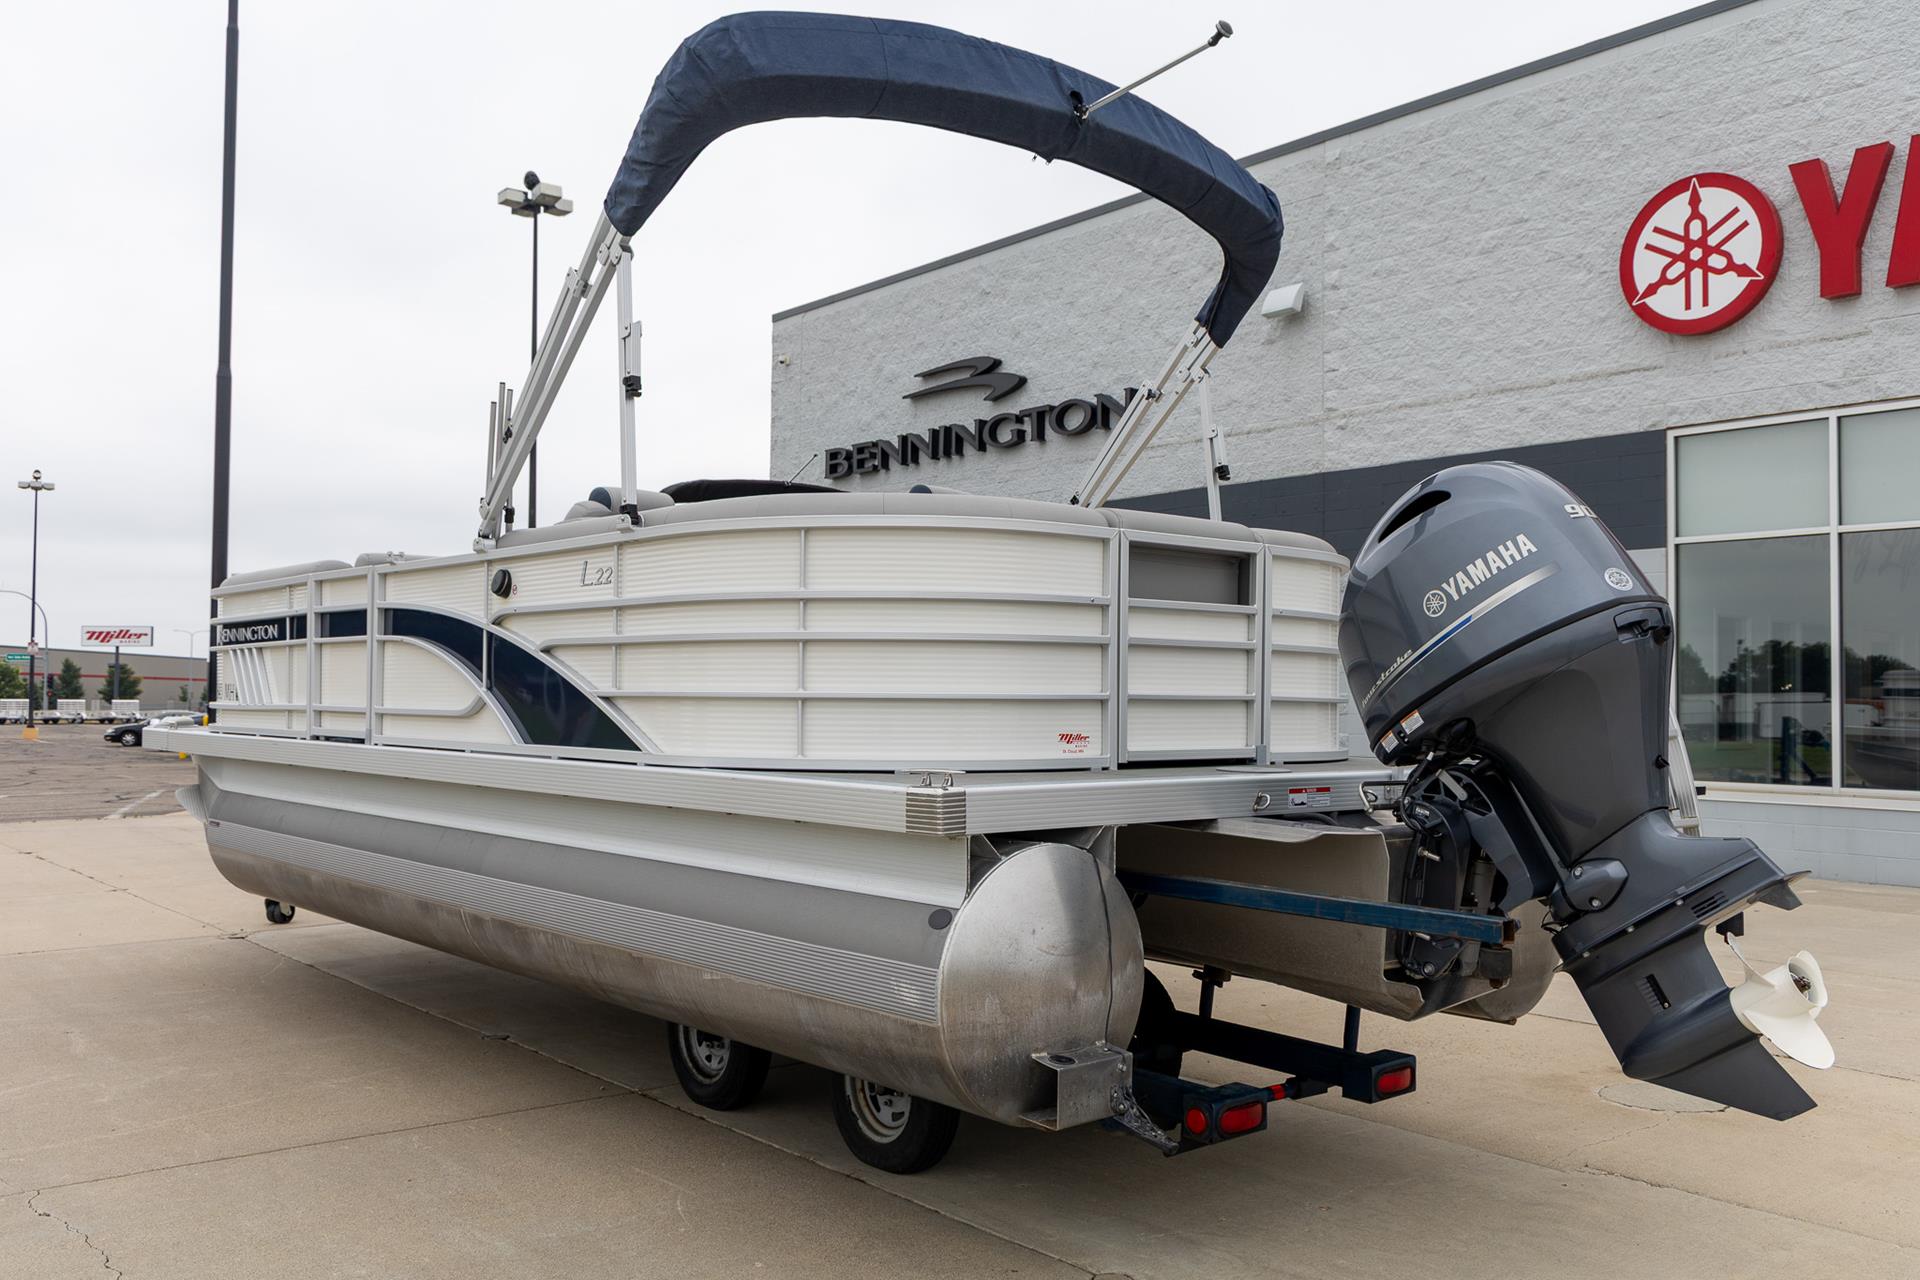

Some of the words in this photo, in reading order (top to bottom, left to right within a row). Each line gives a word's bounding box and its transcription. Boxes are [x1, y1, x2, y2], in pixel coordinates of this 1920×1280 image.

[824, 387, 1141, 480] BENNINGTON
[1441, 533, 1538, 601] YAMAHA
[86, 629, 148, 643] Miller
[1058, 733, 1090, 744] Miller
